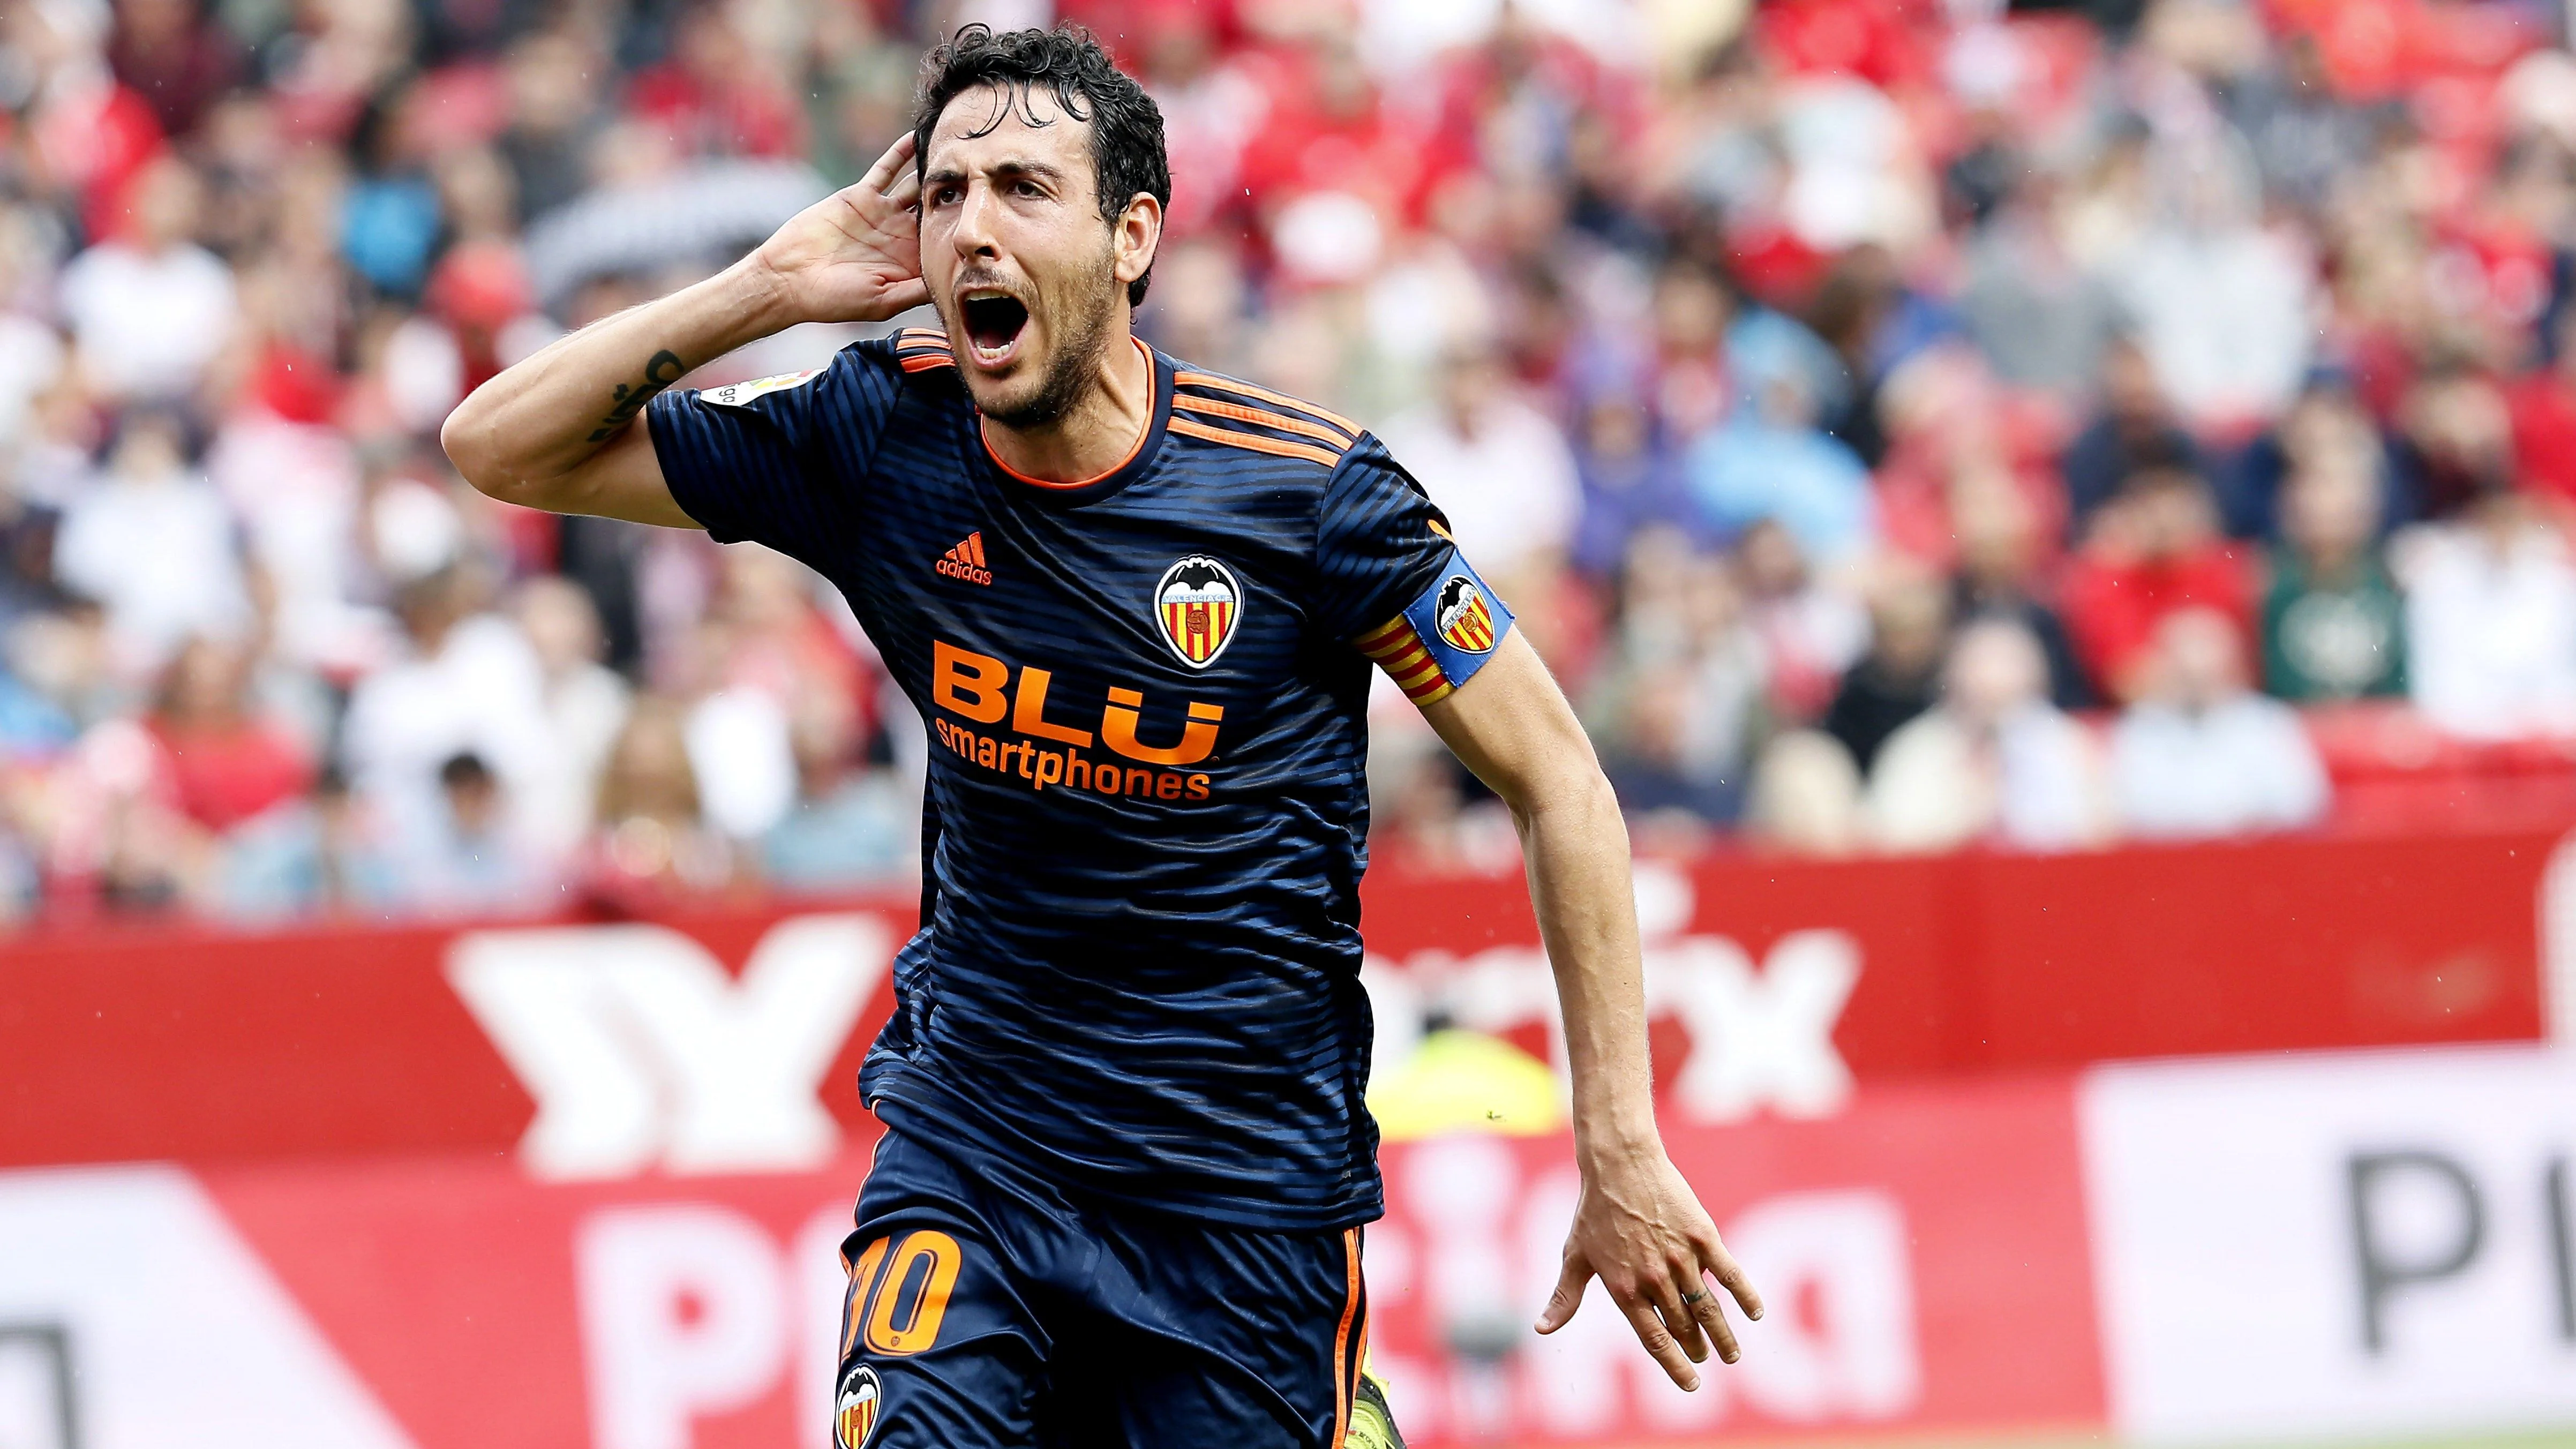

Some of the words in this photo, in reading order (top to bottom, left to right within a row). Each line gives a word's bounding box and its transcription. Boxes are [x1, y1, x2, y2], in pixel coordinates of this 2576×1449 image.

[936, 560, 992, 585] adidas
[1164, 594, 1214, 603] VALENCIA
[1442, 599, 1470, 632] VALENCIA
[936, 717, 1210, 800] smartphones
[842, 1230, 962, 1360] 10
